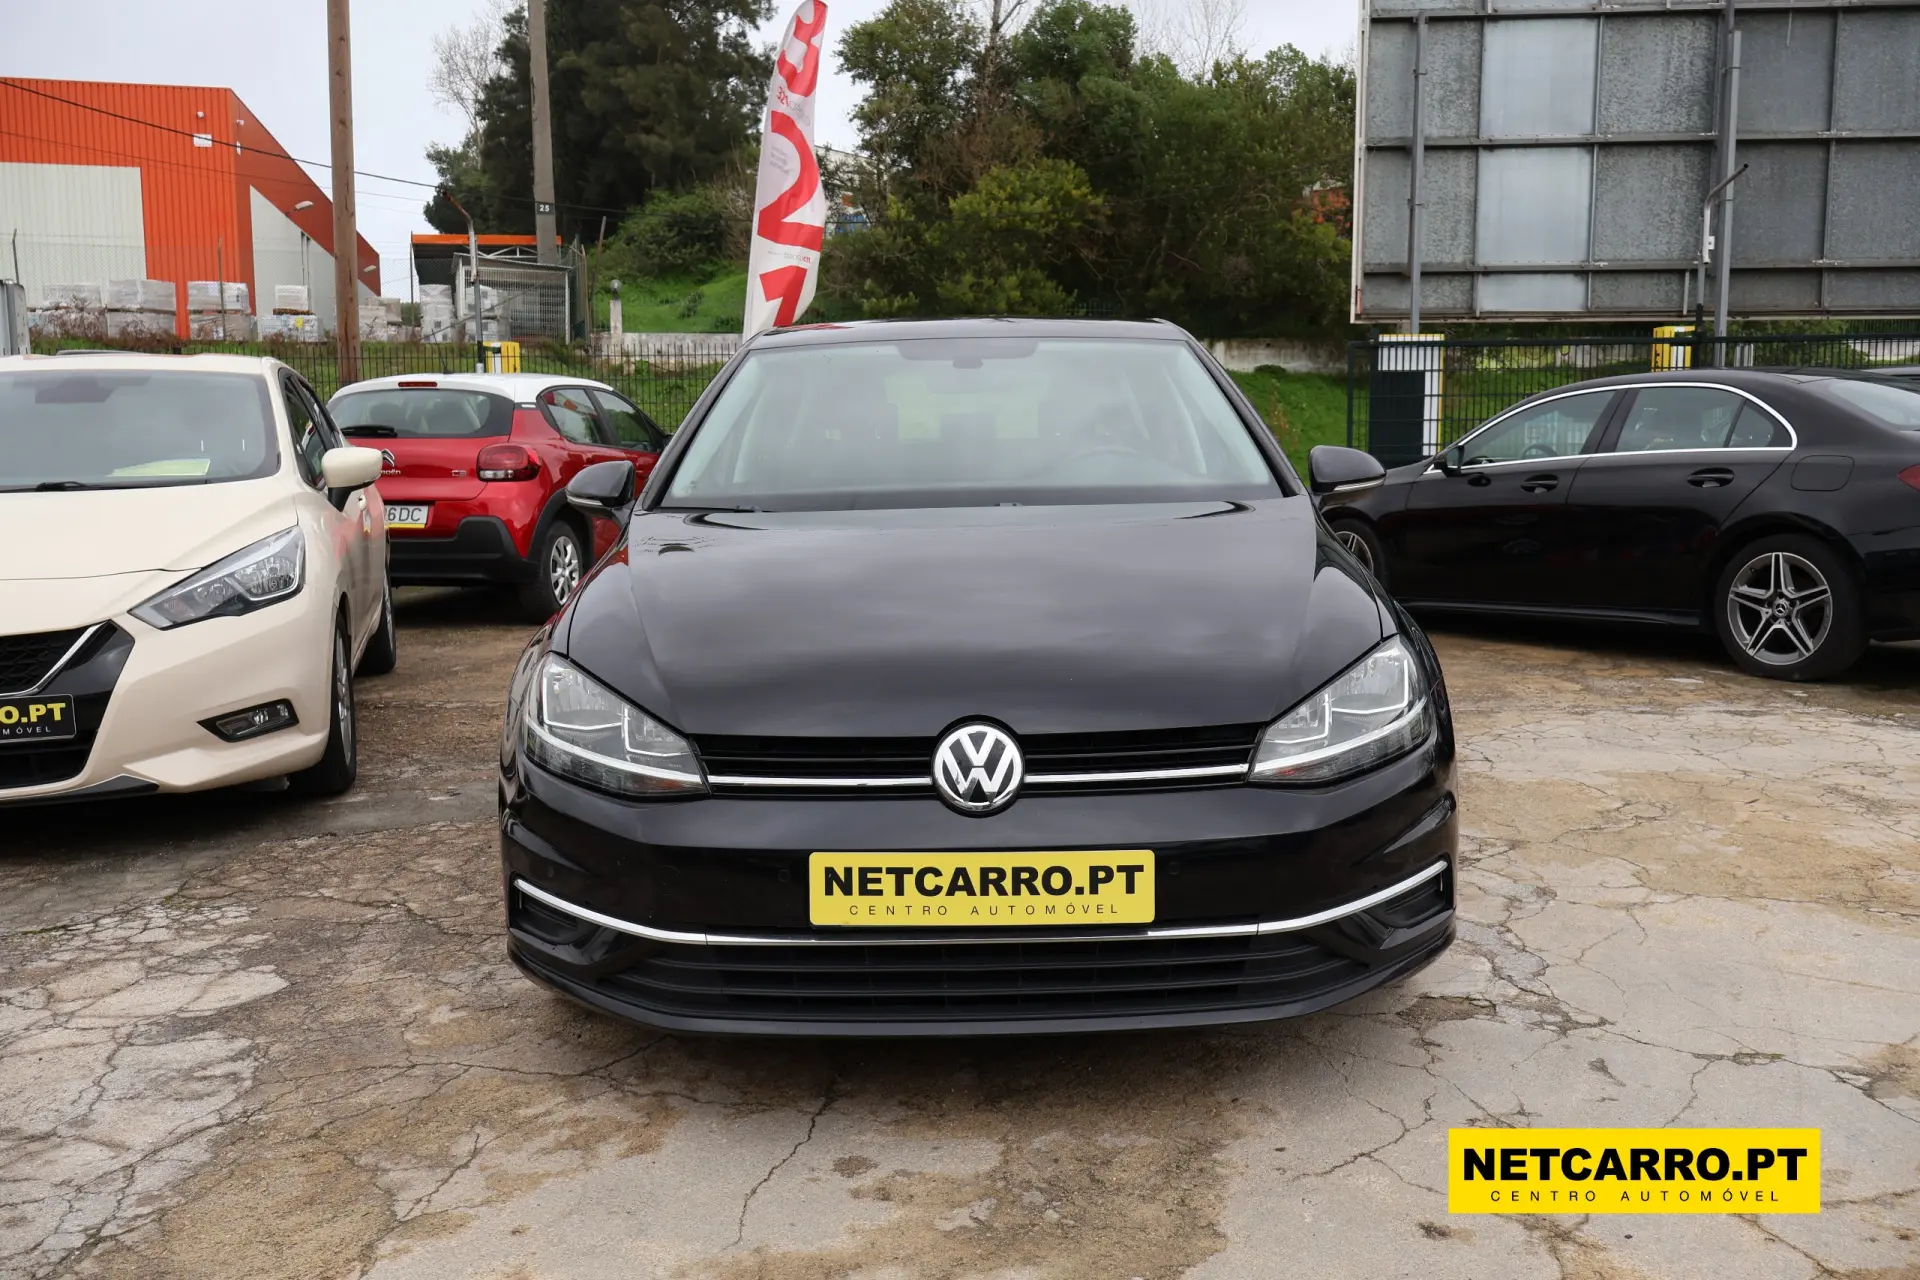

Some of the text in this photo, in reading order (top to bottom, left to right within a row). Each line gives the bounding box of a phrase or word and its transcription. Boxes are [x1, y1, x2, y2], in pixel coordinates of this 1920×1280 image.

[539, 204, 550, 212] 25
[823, 864, 1145, 897] NETCARRO.PT
[849, 903, 1119, 916] CENTRO AUTOMÓVEL
